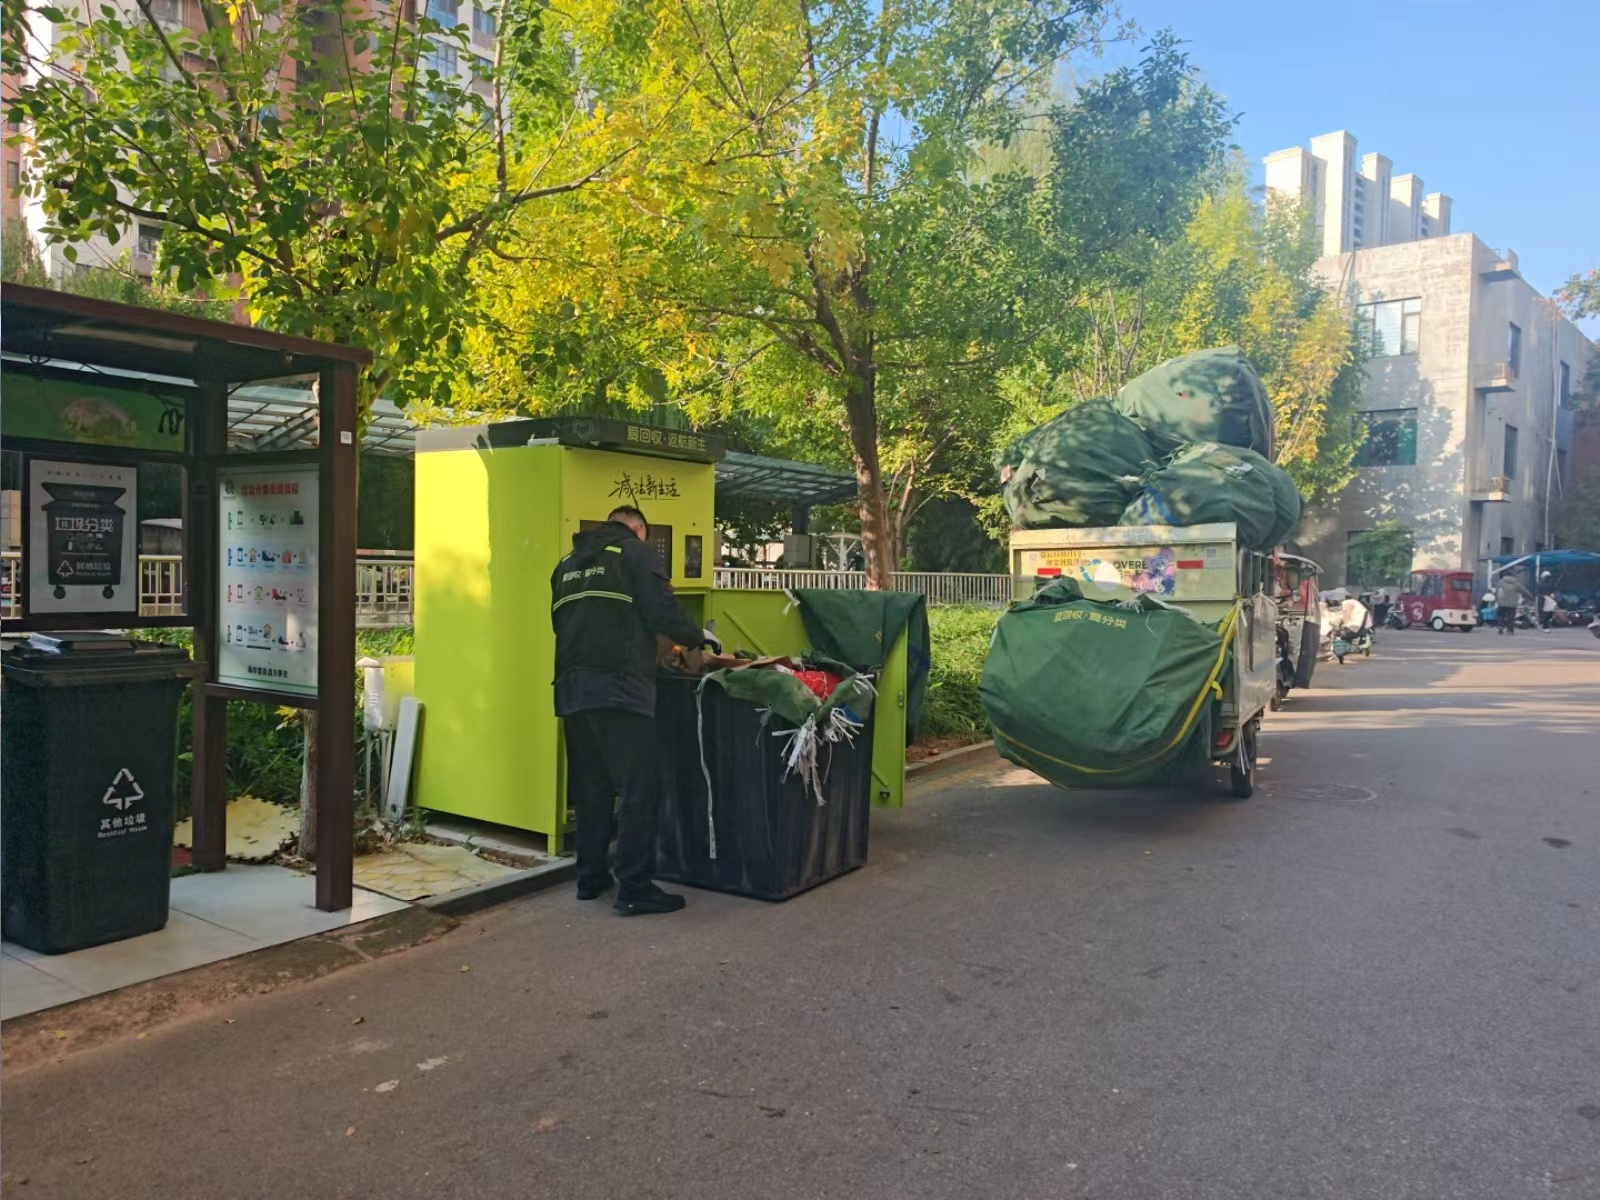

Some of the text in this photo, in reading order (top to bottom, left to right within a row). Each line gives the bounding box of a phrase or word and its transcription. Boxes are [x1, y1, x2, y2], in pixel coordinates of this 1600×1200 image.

[100, 813, 146, 830] 其他垃圾
[97, 828, 127, 838] Residual
